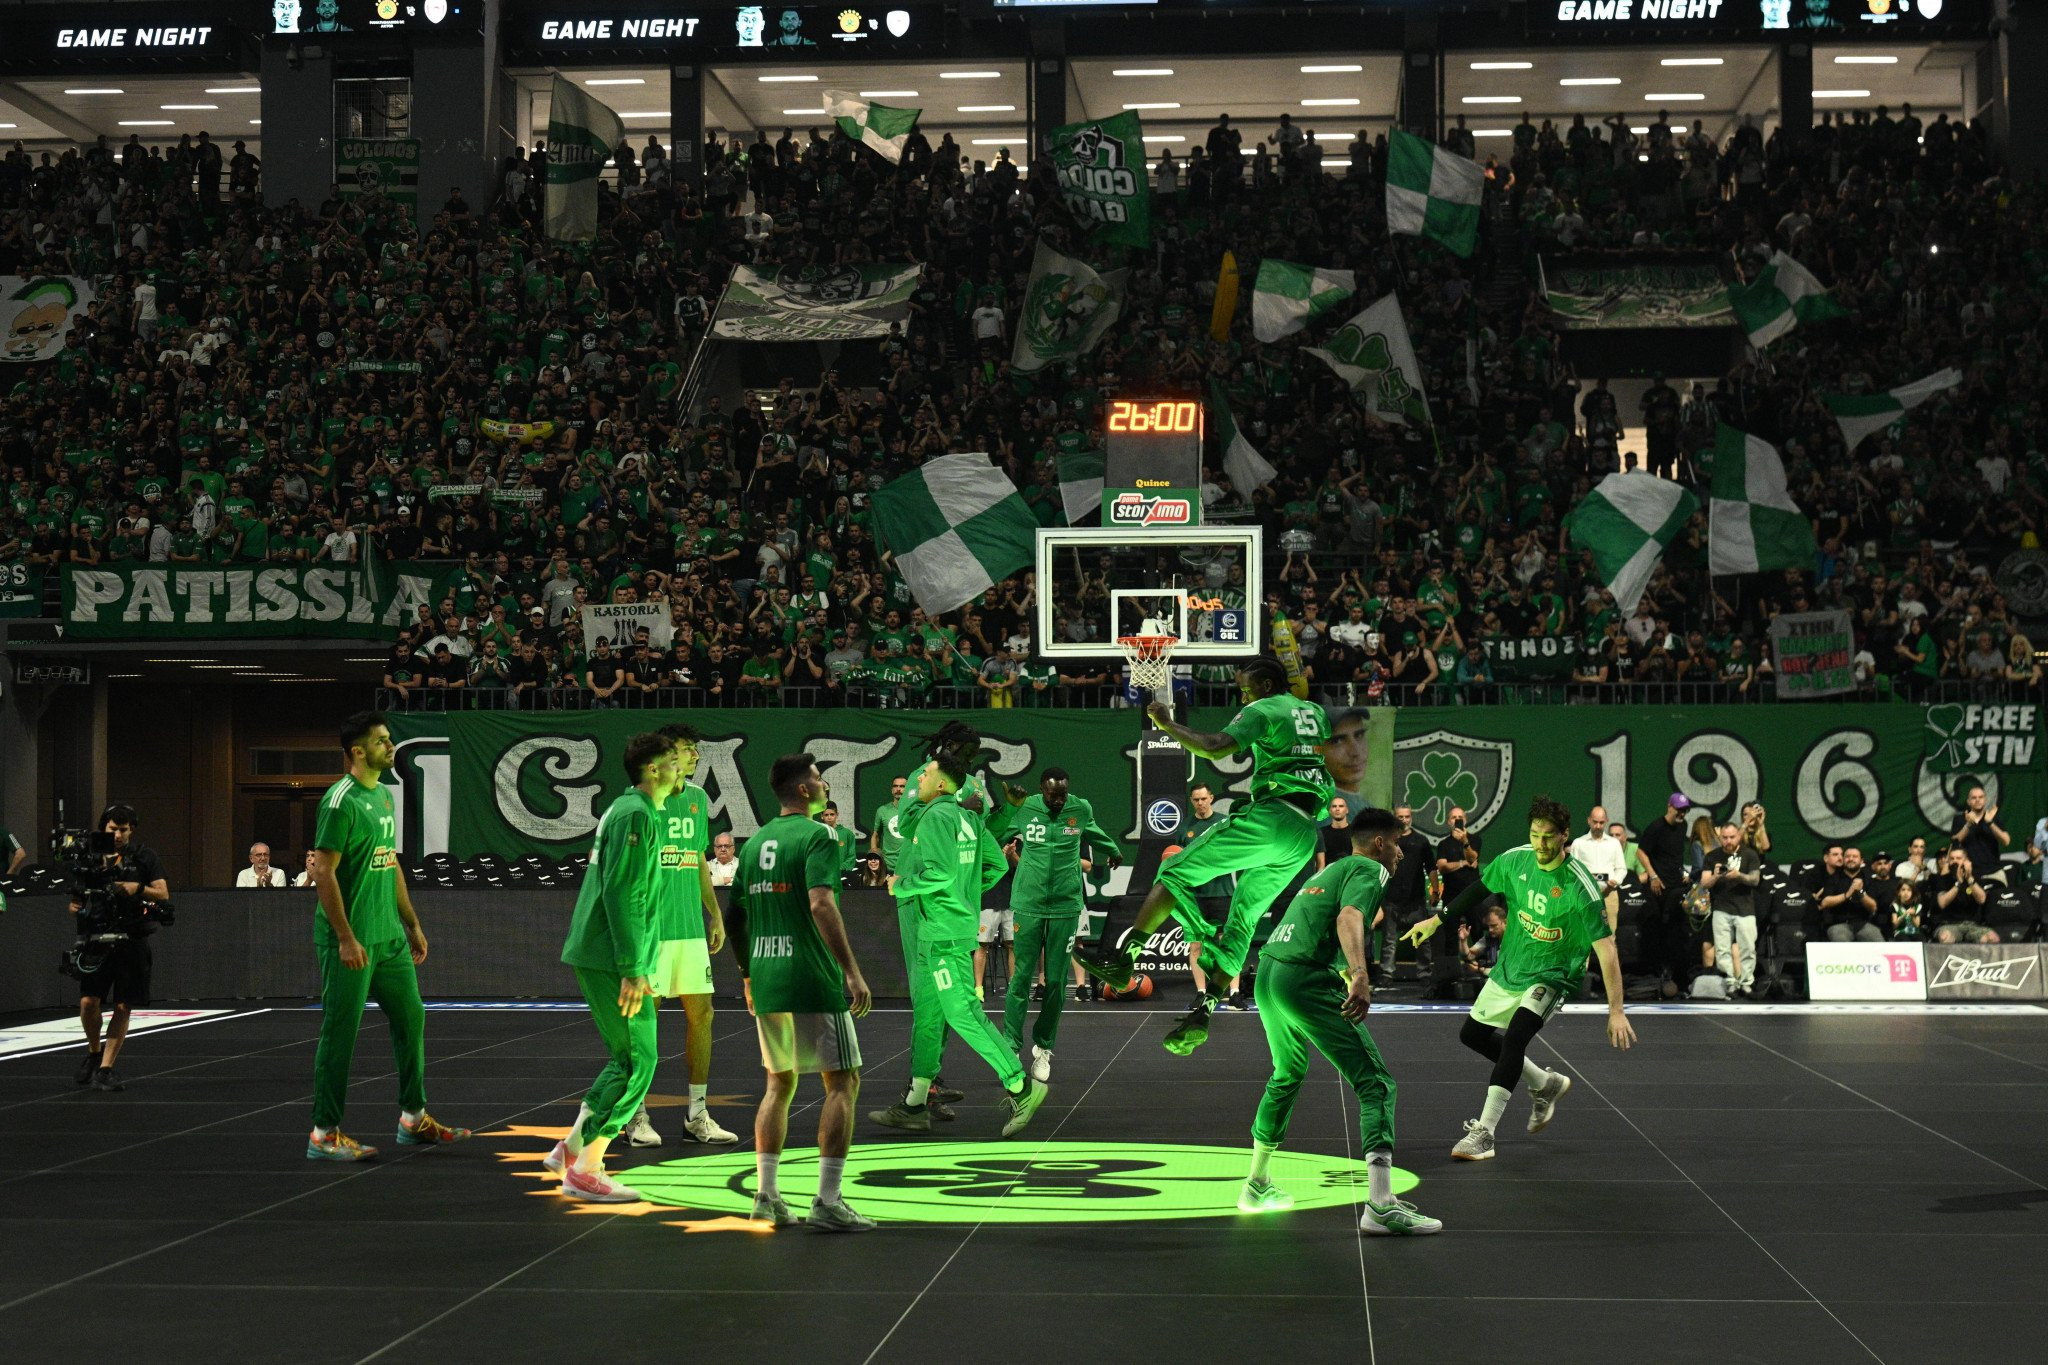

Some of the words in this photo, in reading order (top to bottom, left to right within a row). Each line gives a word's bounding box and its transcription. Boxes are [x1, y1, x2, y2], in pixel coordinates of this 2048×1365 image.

[1557, 0, 1631, 20] GAME
[1641, 0, 1723, 19] NIGHT
[56, 28, 126, 47] GAME
[134, 27, 211, 46] NIGHT
[541, 20, 614, 39] GAME
[622, 18, 700, 38] NIGHT
[1109, 402, 1196, 431] 26:00
[1135, 479, 1170, 488] Quince
[70, 567, 433, 627] PATISSIA
[593, 604, 662, 618] KASTORIA
[1220, 632, 1239, 640] GBL
[1291, 708, 1320, 736] 25
[1965, 704, 2037, 731] FREE
[1147, 740, 1182, 750] SPALDING
[380, 815, 396, 839] 77
[668, 817, 695, 839] 20
[1026, 824, 1047, 843] 22
[759, 839, 779, 870] 6
[1527, 889, 1548, 916] 16
[752, 935, 794, 958] ATHENS
[1133, 962, 1156, 971] ERO
[1159, 962, 1192, 971] SUGA
[1948, 958, 2011, 982] Bud
[932, 967, 953, 992] 10
